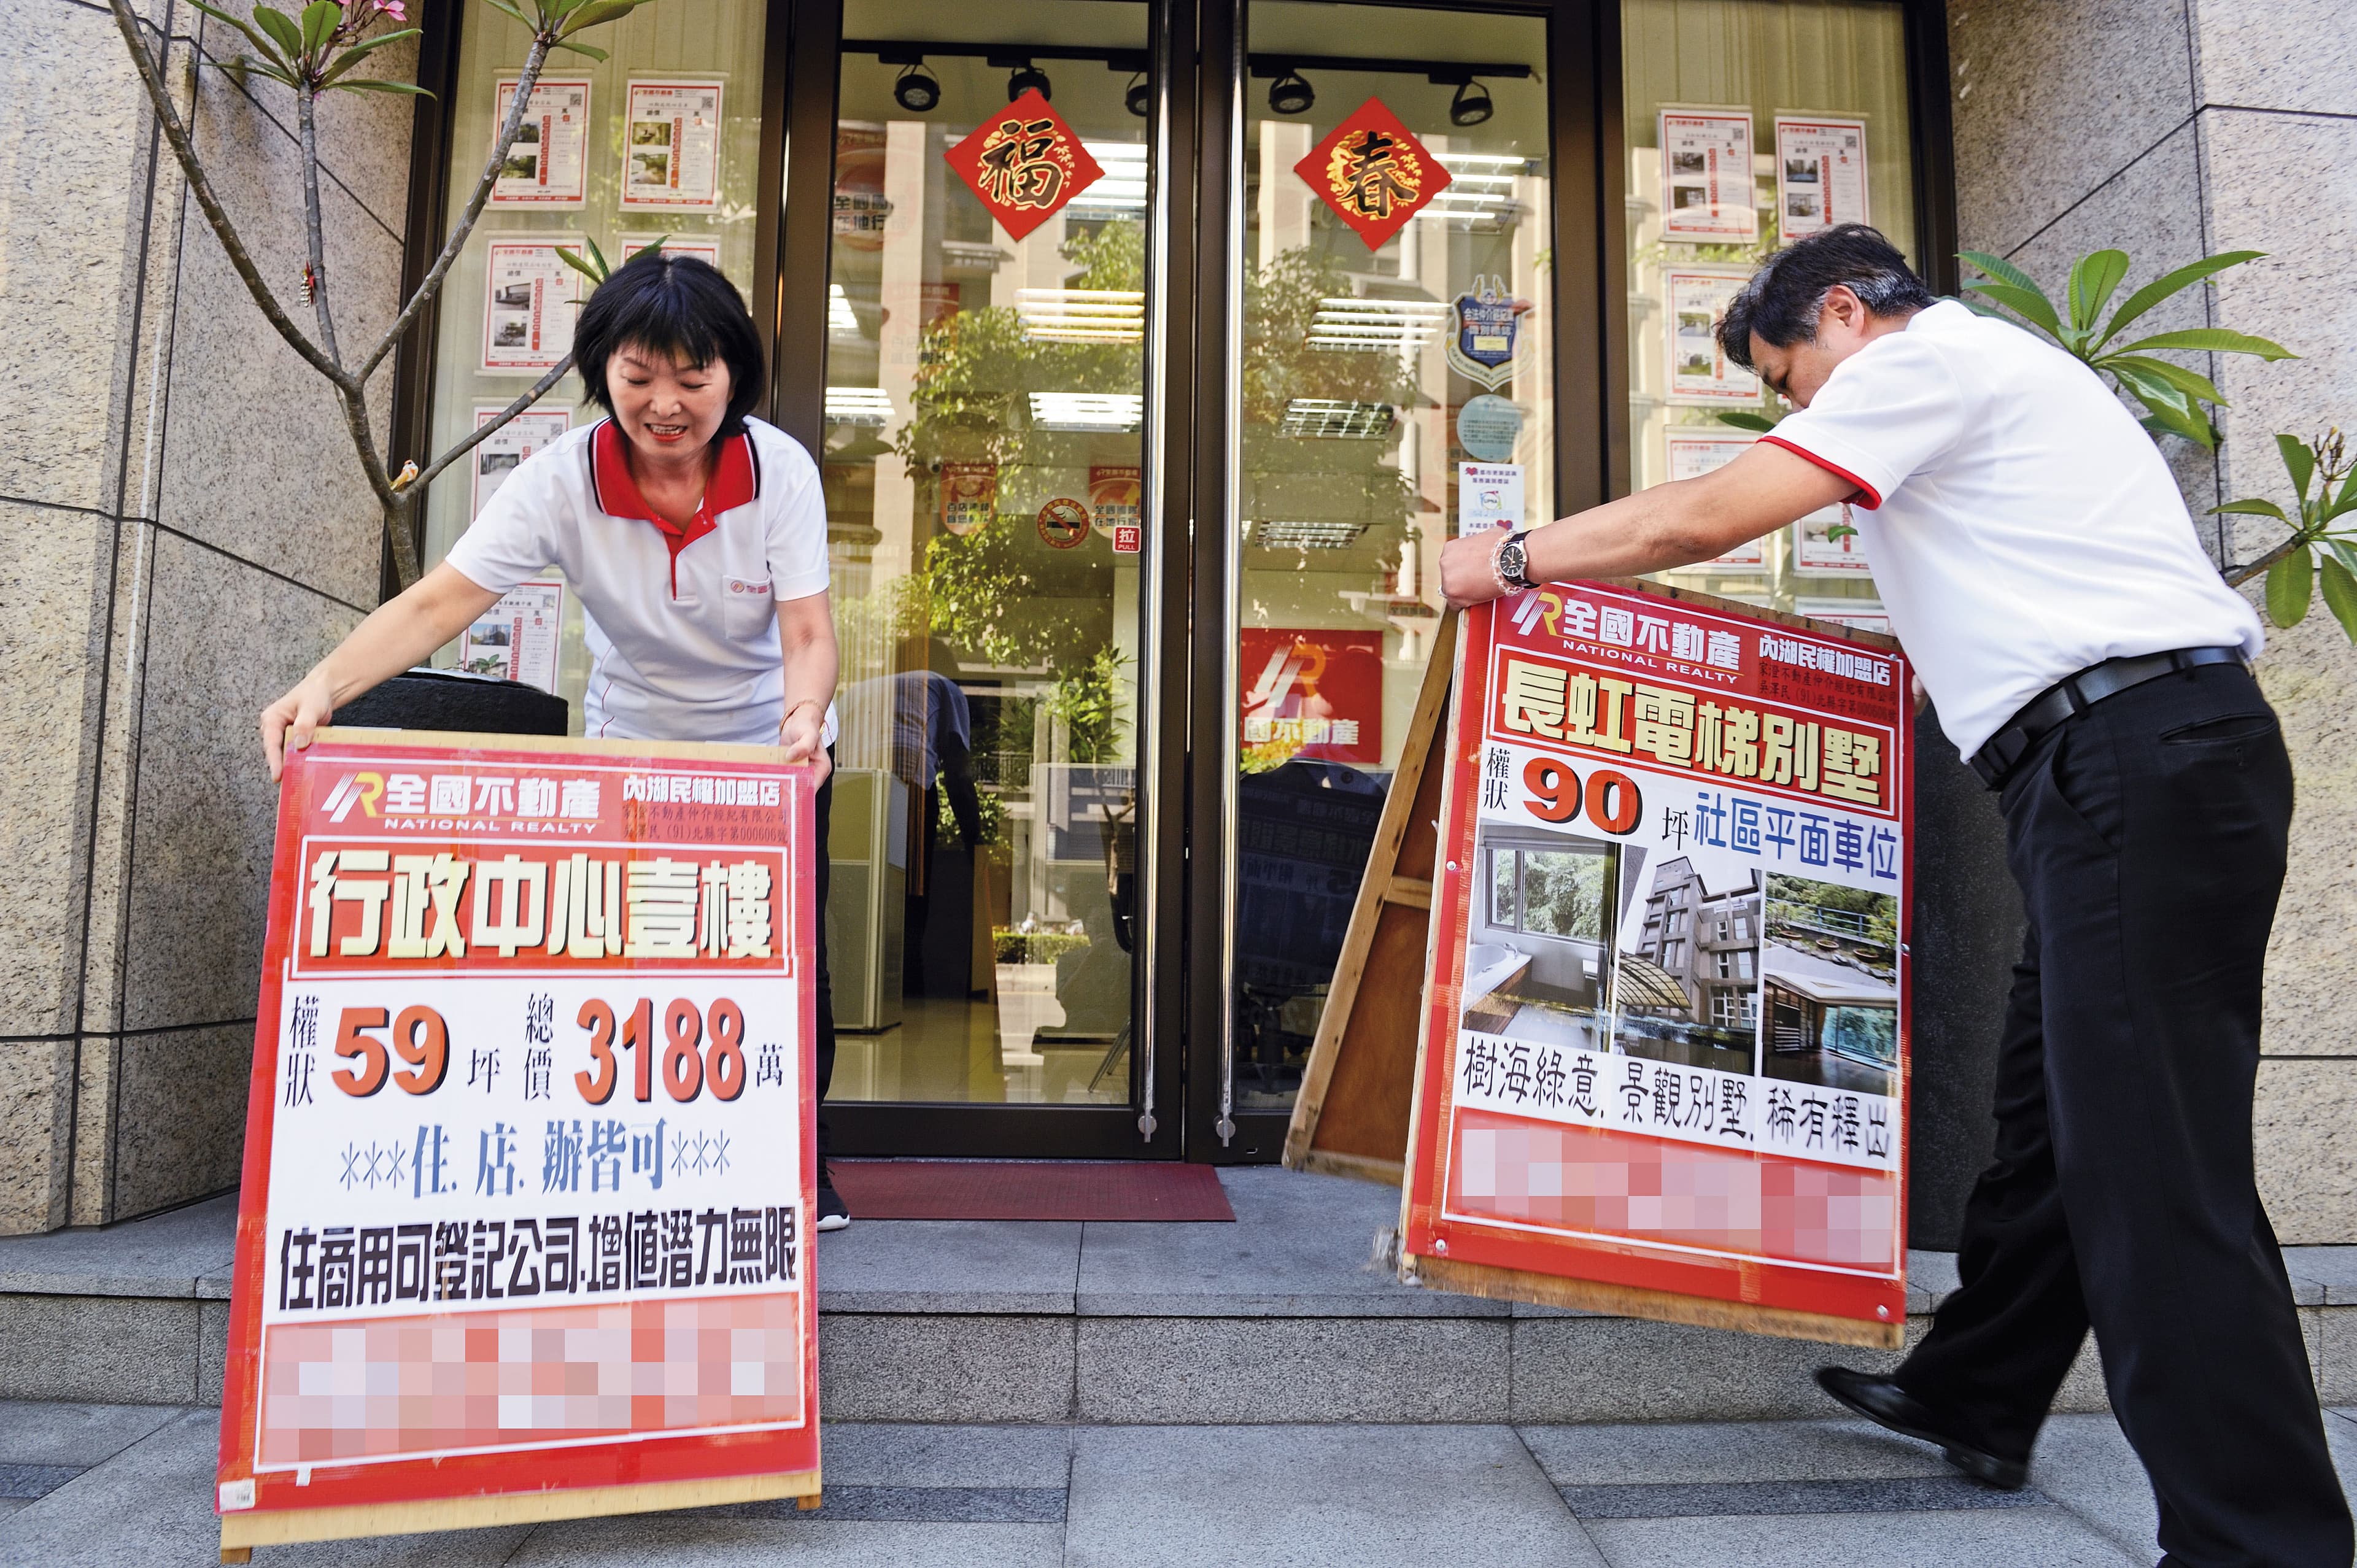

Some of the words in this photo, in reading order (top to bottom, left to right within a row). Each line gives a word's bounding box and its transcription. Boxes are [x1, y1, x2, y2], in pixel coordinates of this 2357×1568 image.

[977, 118, 1064, 209] 福
[1336, 129, 1420, 220] 春
[1118, 528, 1136, 543] 拉
[1563, 598, 1740, 671] 全國不動產
[1563, 639, 1657, 668] NATIONAL
[1666, 662, 1738, 684] REALTY
[1759, 634, 1891, 687] 內湖民權加盟店
[1501, 658, 1882, 806] 長虹電梯別墅
[384, 818, 501, 832] NATIONAL
[511, 821, 598, 834] REALTY
[385, 773, 601, 820] 全國不動產
[622, 774, 781, 807] 內湖民權加盟店
[1483, 746, 1511, 811] 權狀
[1523, 757, 1643, 836] 90
[1662, 806, 1689, 851] 坪
[1694, 792, 1898, 881] 社區平面車位
[309, 849, 772, 959] 行政中心壹樓
[284, 995, 320, 1108] 權狀
[331, 1005, 450, 1097] 59
[466, 1047, 501, 1094] 坪
[523, 992, 554, 1102] 總價
[575, 997, 749, 1105] 3188
[754, 1043, 783, 1088] 萬
